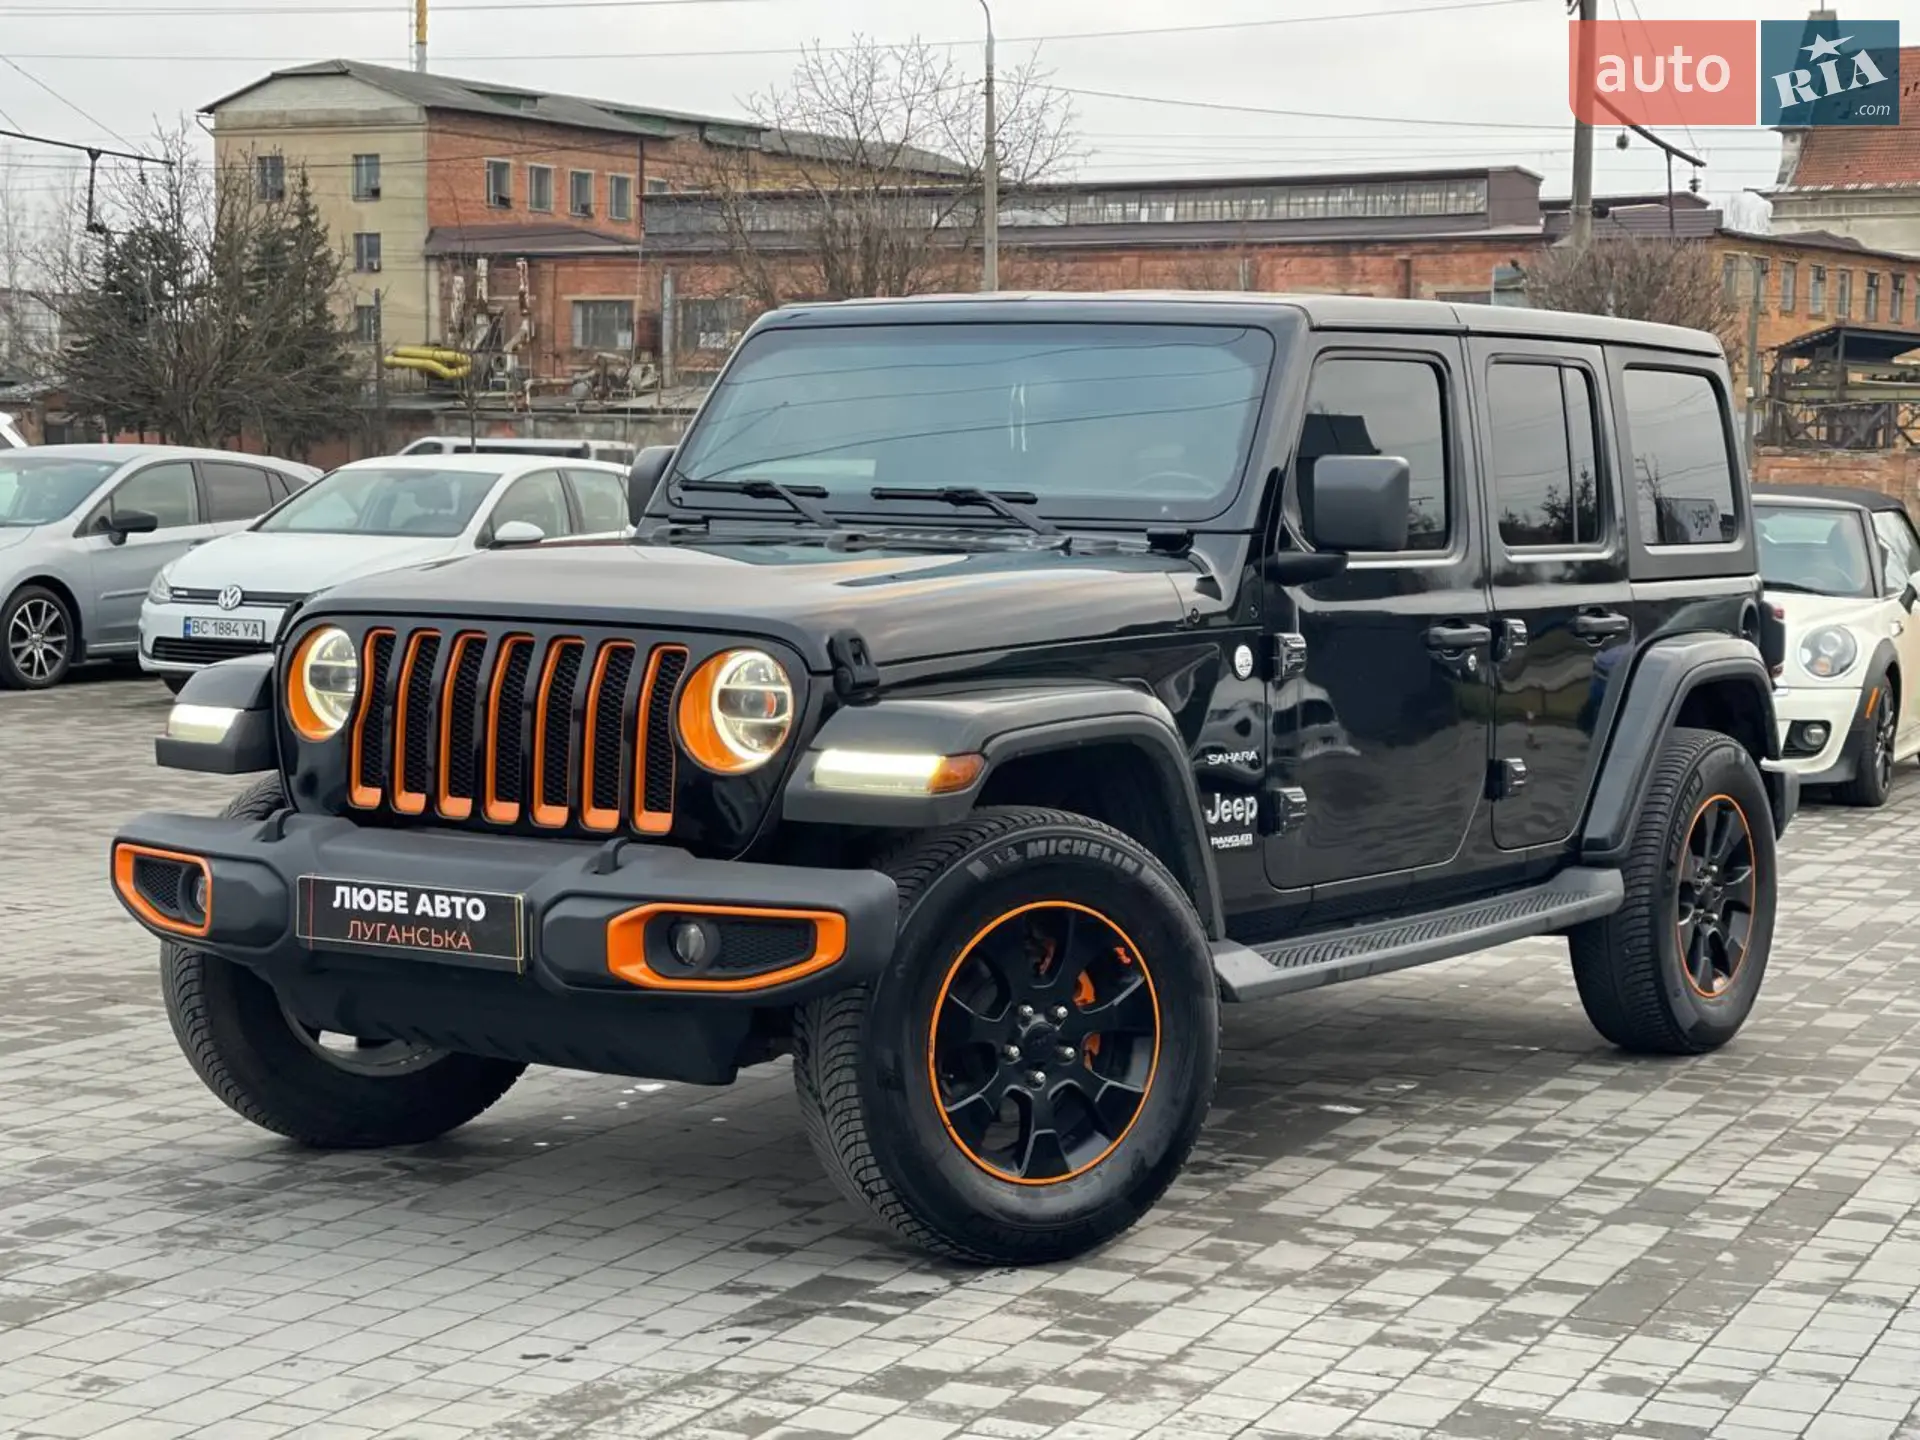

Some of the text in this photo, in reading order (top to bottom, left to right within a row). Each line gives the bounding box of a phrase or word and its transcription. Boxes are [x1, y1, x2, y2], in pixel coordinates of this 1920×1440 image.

[191, 620, 210, 634] BC
[212, 622, 239, 637] 1884
[1206, 750, 1258, 766] SAHARA
[1206, 793, 1258, 826] Jeep
[1026, 837, 1139, 875] MICHELIN
[332, 885, 486, 922] ЛЮБЕ АВТО
[348, 919, 472, 951] ЛУГАНСЬКА
